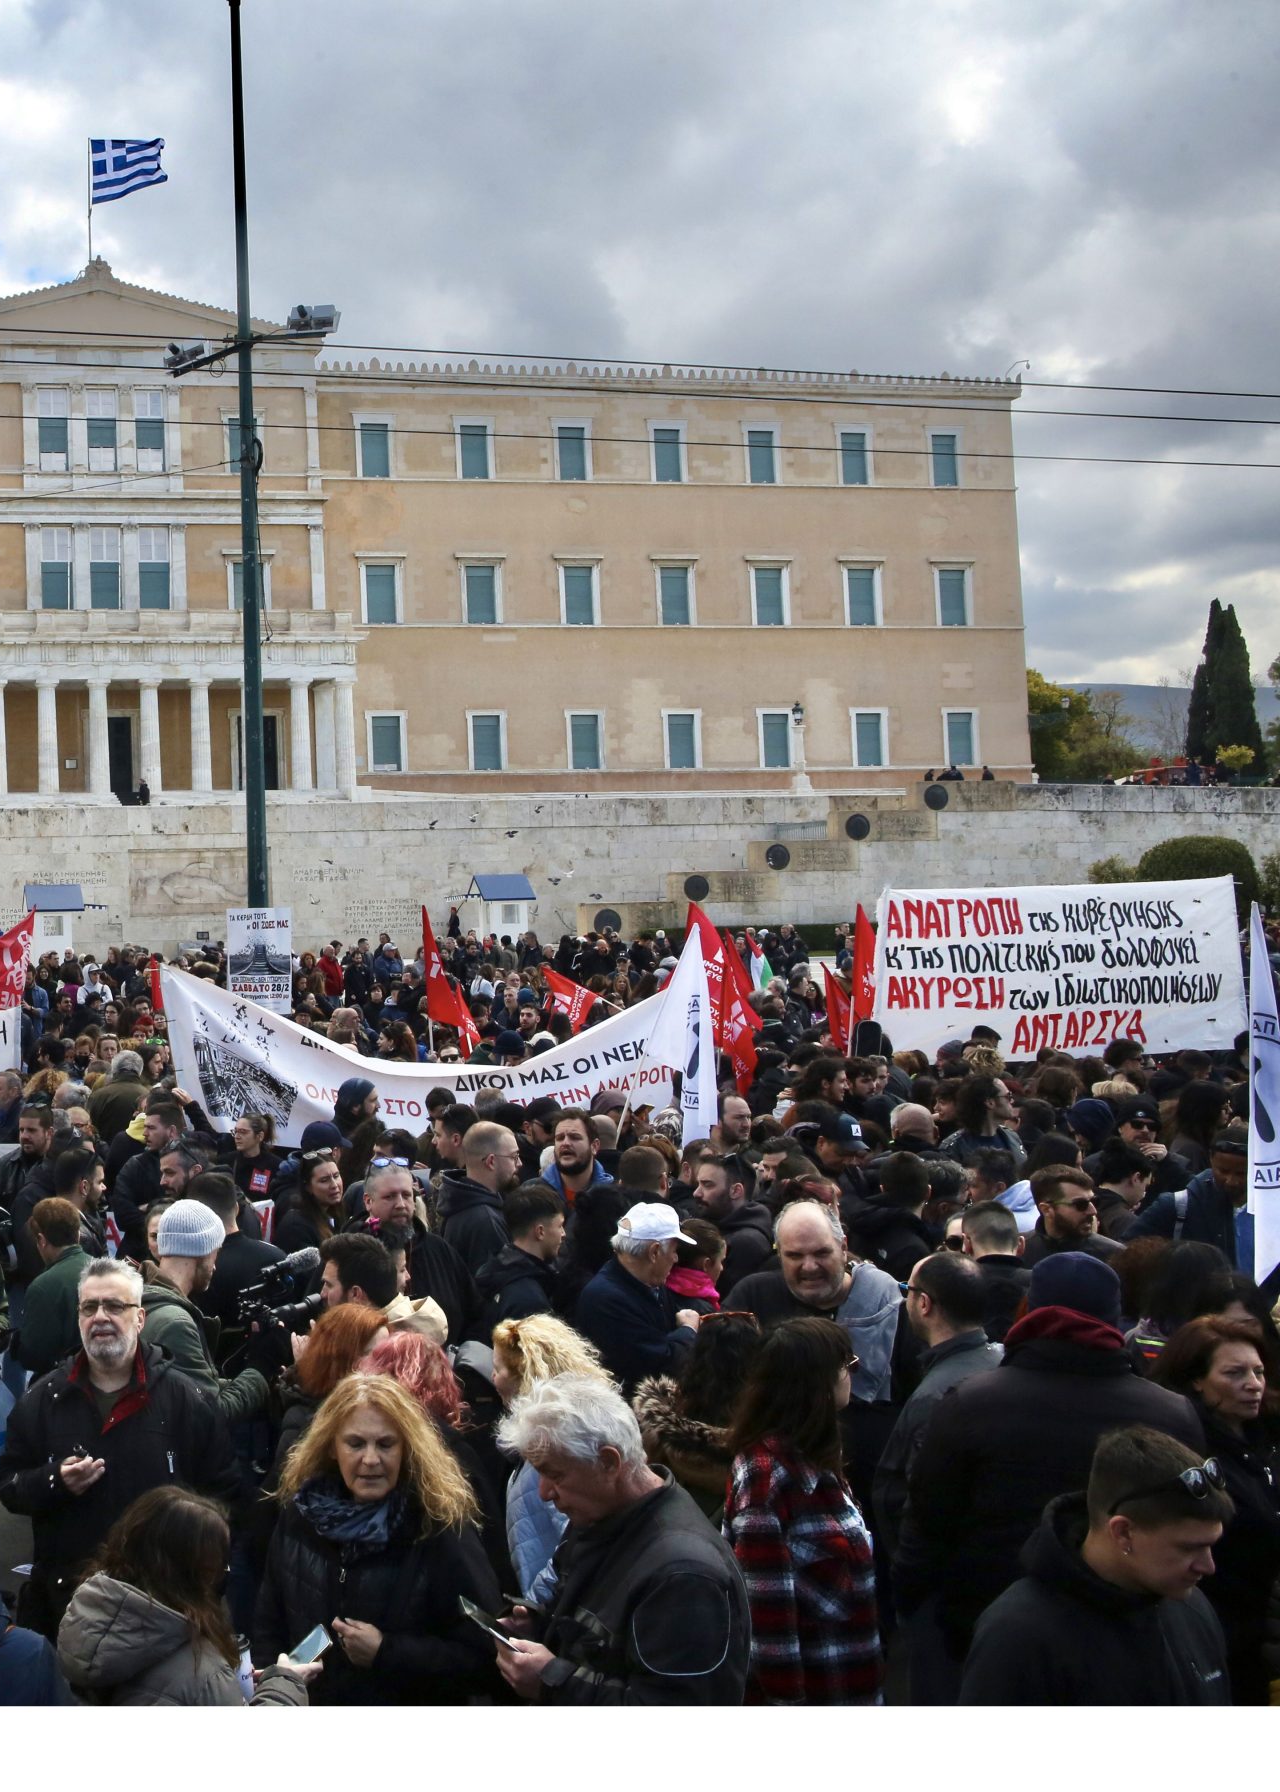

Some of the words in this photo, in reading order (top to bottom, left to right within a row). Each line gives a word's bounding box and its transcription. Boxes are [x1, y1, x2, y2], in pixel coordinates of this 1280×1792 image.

[252, 922, 260, 930] ΟΙ
[276, 919, 289, 929] ΜΑΣ
[887, 897, 1023, 939] ΑΝΑΤΡΟΠΗ
[231, 983, 270, 992] ΣΑΒΒΑΤΟ
[271, 983, 290, 992] 28/2
[887, 975, 1004, 1010] ΑΚΥΡΩΣΗ
[455, 1072, 514, 1092] ΔΙΚΟΙ
[519, 1062, 569, 1087] ΜΑΣ
[572, 1055, 598, 1074] ΟΙ
[602, 1037, 649, 1066] ΝΕΚ
[384, 1098, 422, 1117] ΣΤΟ
